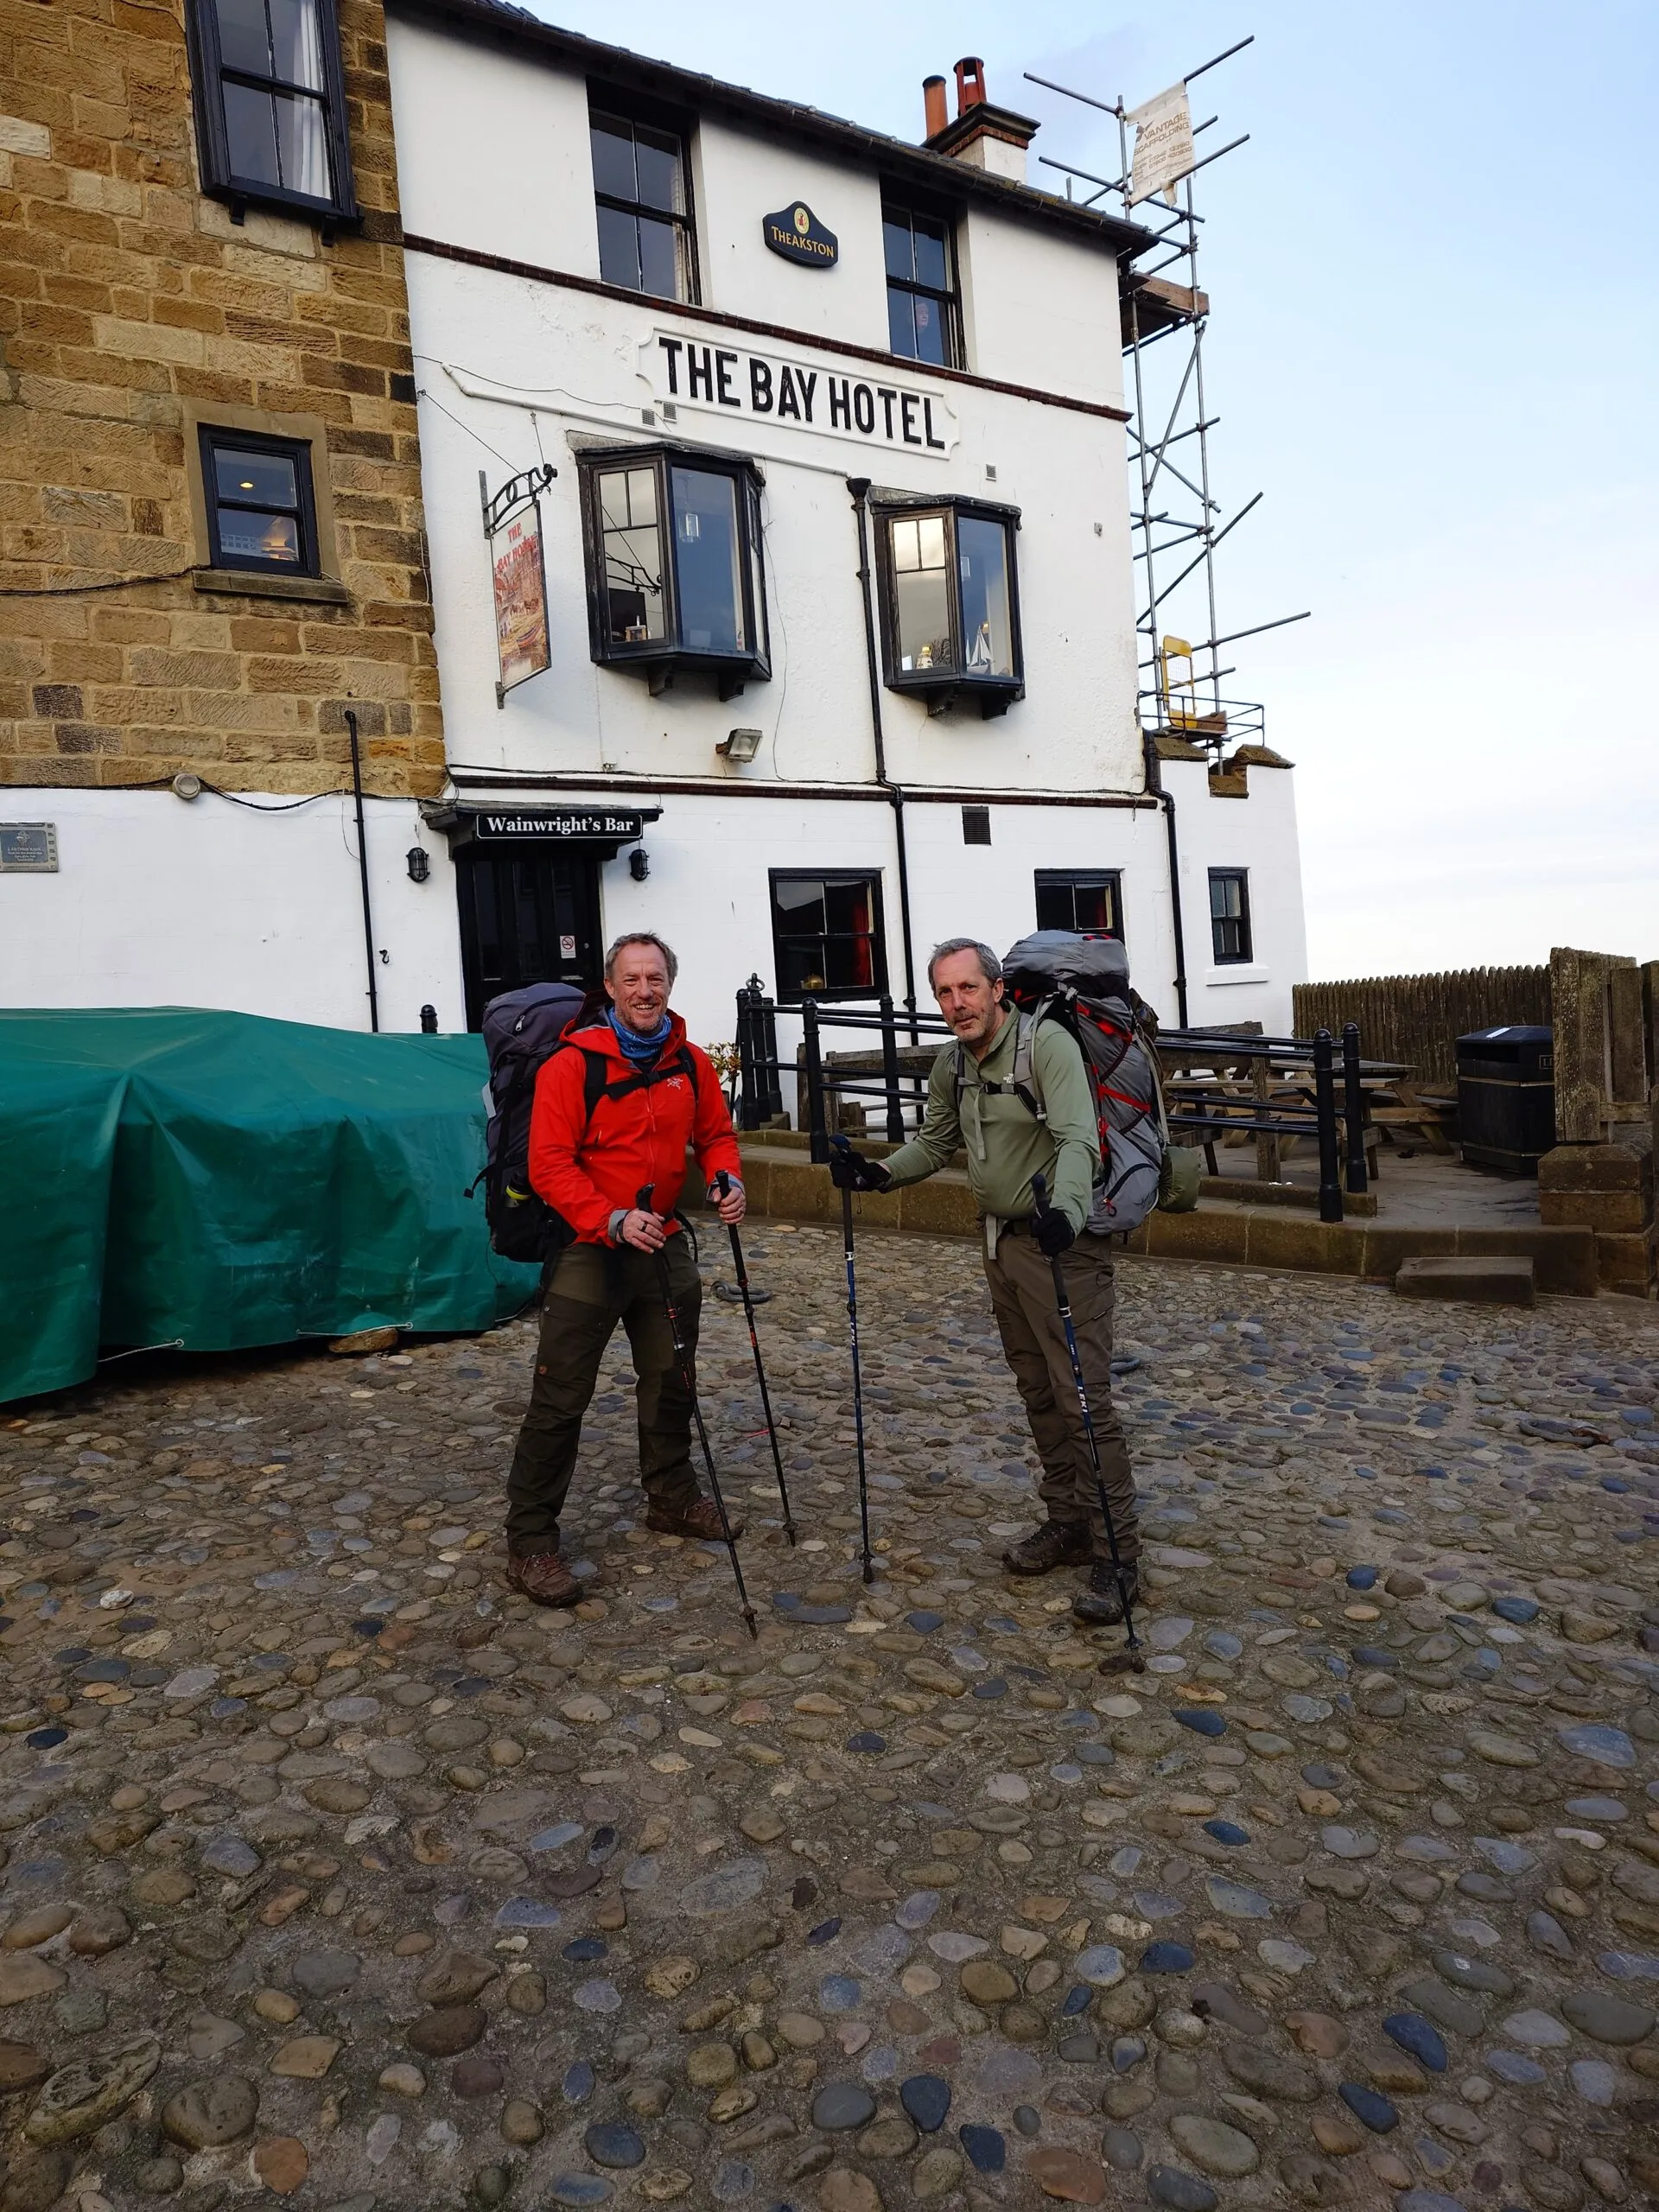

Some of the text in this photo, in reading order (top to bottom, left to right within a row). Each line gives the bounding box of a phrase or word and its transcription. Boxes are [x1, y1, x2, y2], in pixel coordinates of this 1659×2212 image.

[1134, 122, 1189, 156] SCAFFOLDING
[1144, 111, 1187, 140] VANTAGE
[771, 226, 835, 258] THEAKSTON
[658, 336, 945, 450] THE BAY HOTEL
[507, 522, 523, 543] THE
[486, 817, 634, 836] Wainwright's Bar
[1077, 1385, 1089, 1414] LEKI
